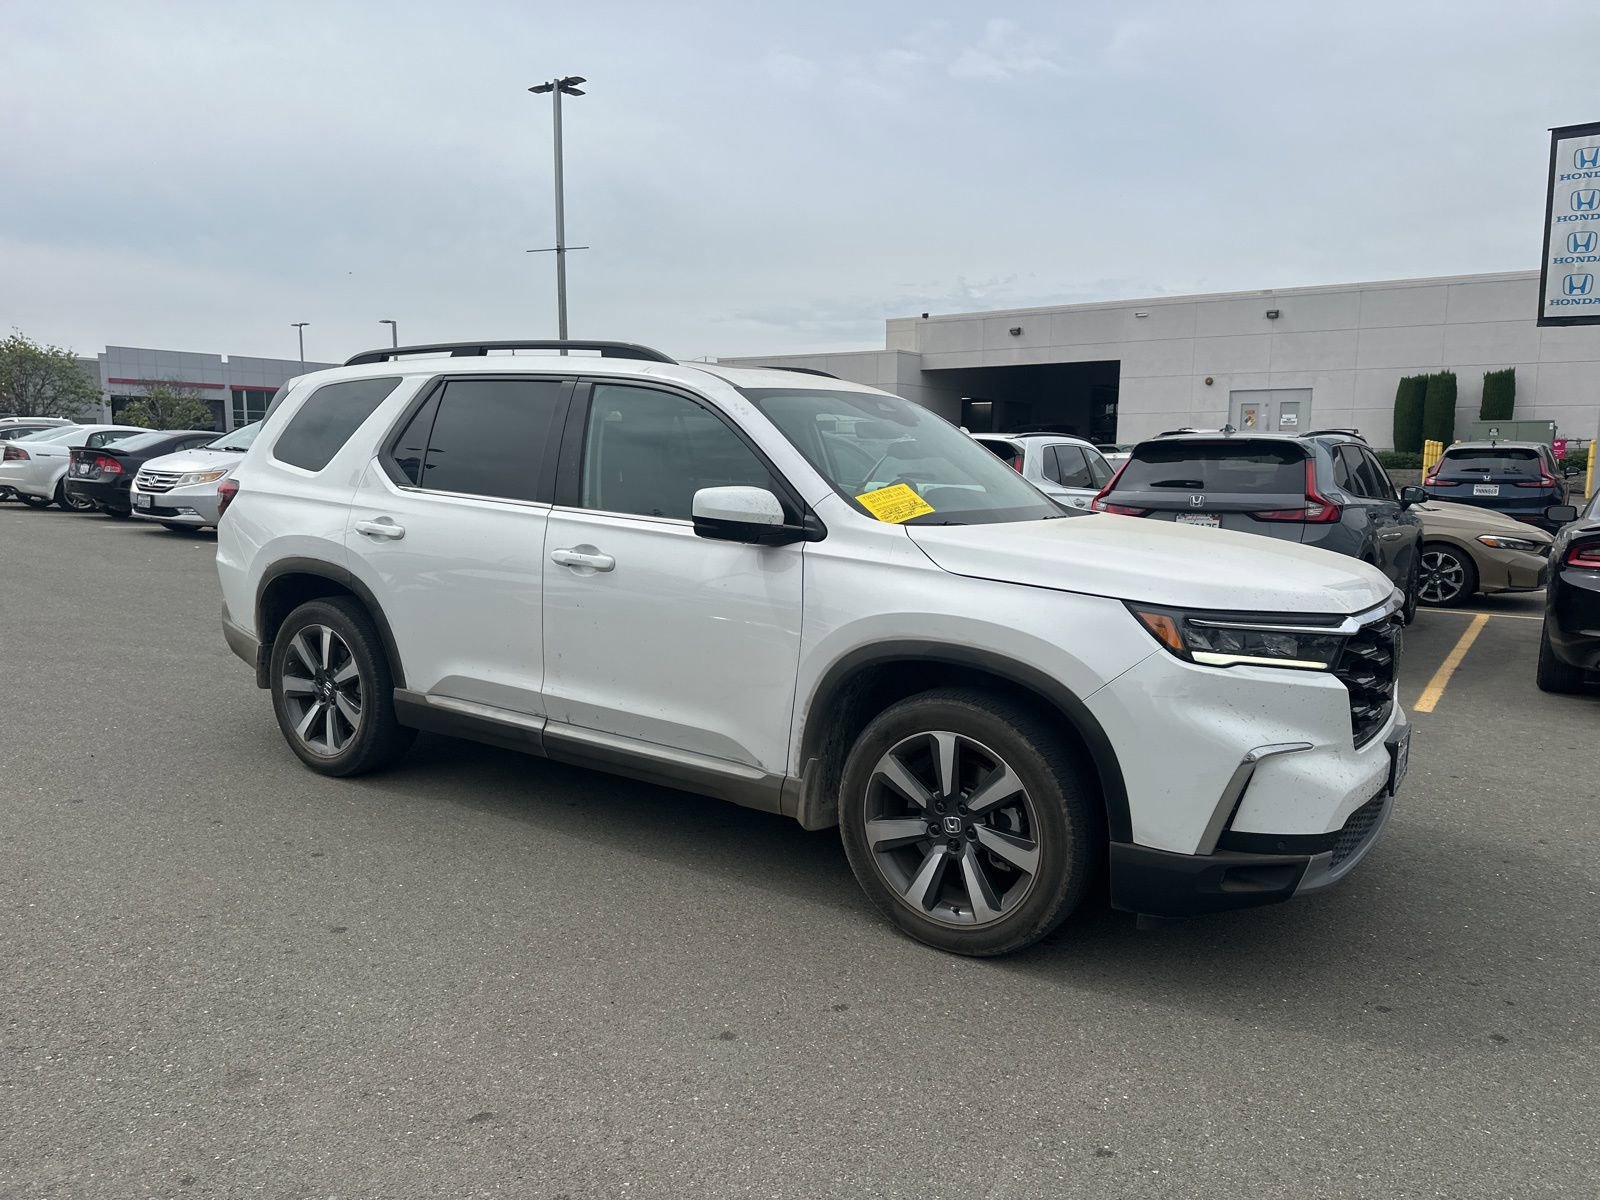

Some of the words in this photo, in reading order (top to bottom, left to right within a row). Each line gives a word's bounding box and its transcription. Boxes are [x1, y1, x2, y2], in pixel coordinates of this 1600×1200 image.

[1559, 170, 1600, 181] HOND
[1556, 213, 1600, 223] HOND
[1549, 297, 1600, 306] HONDA
